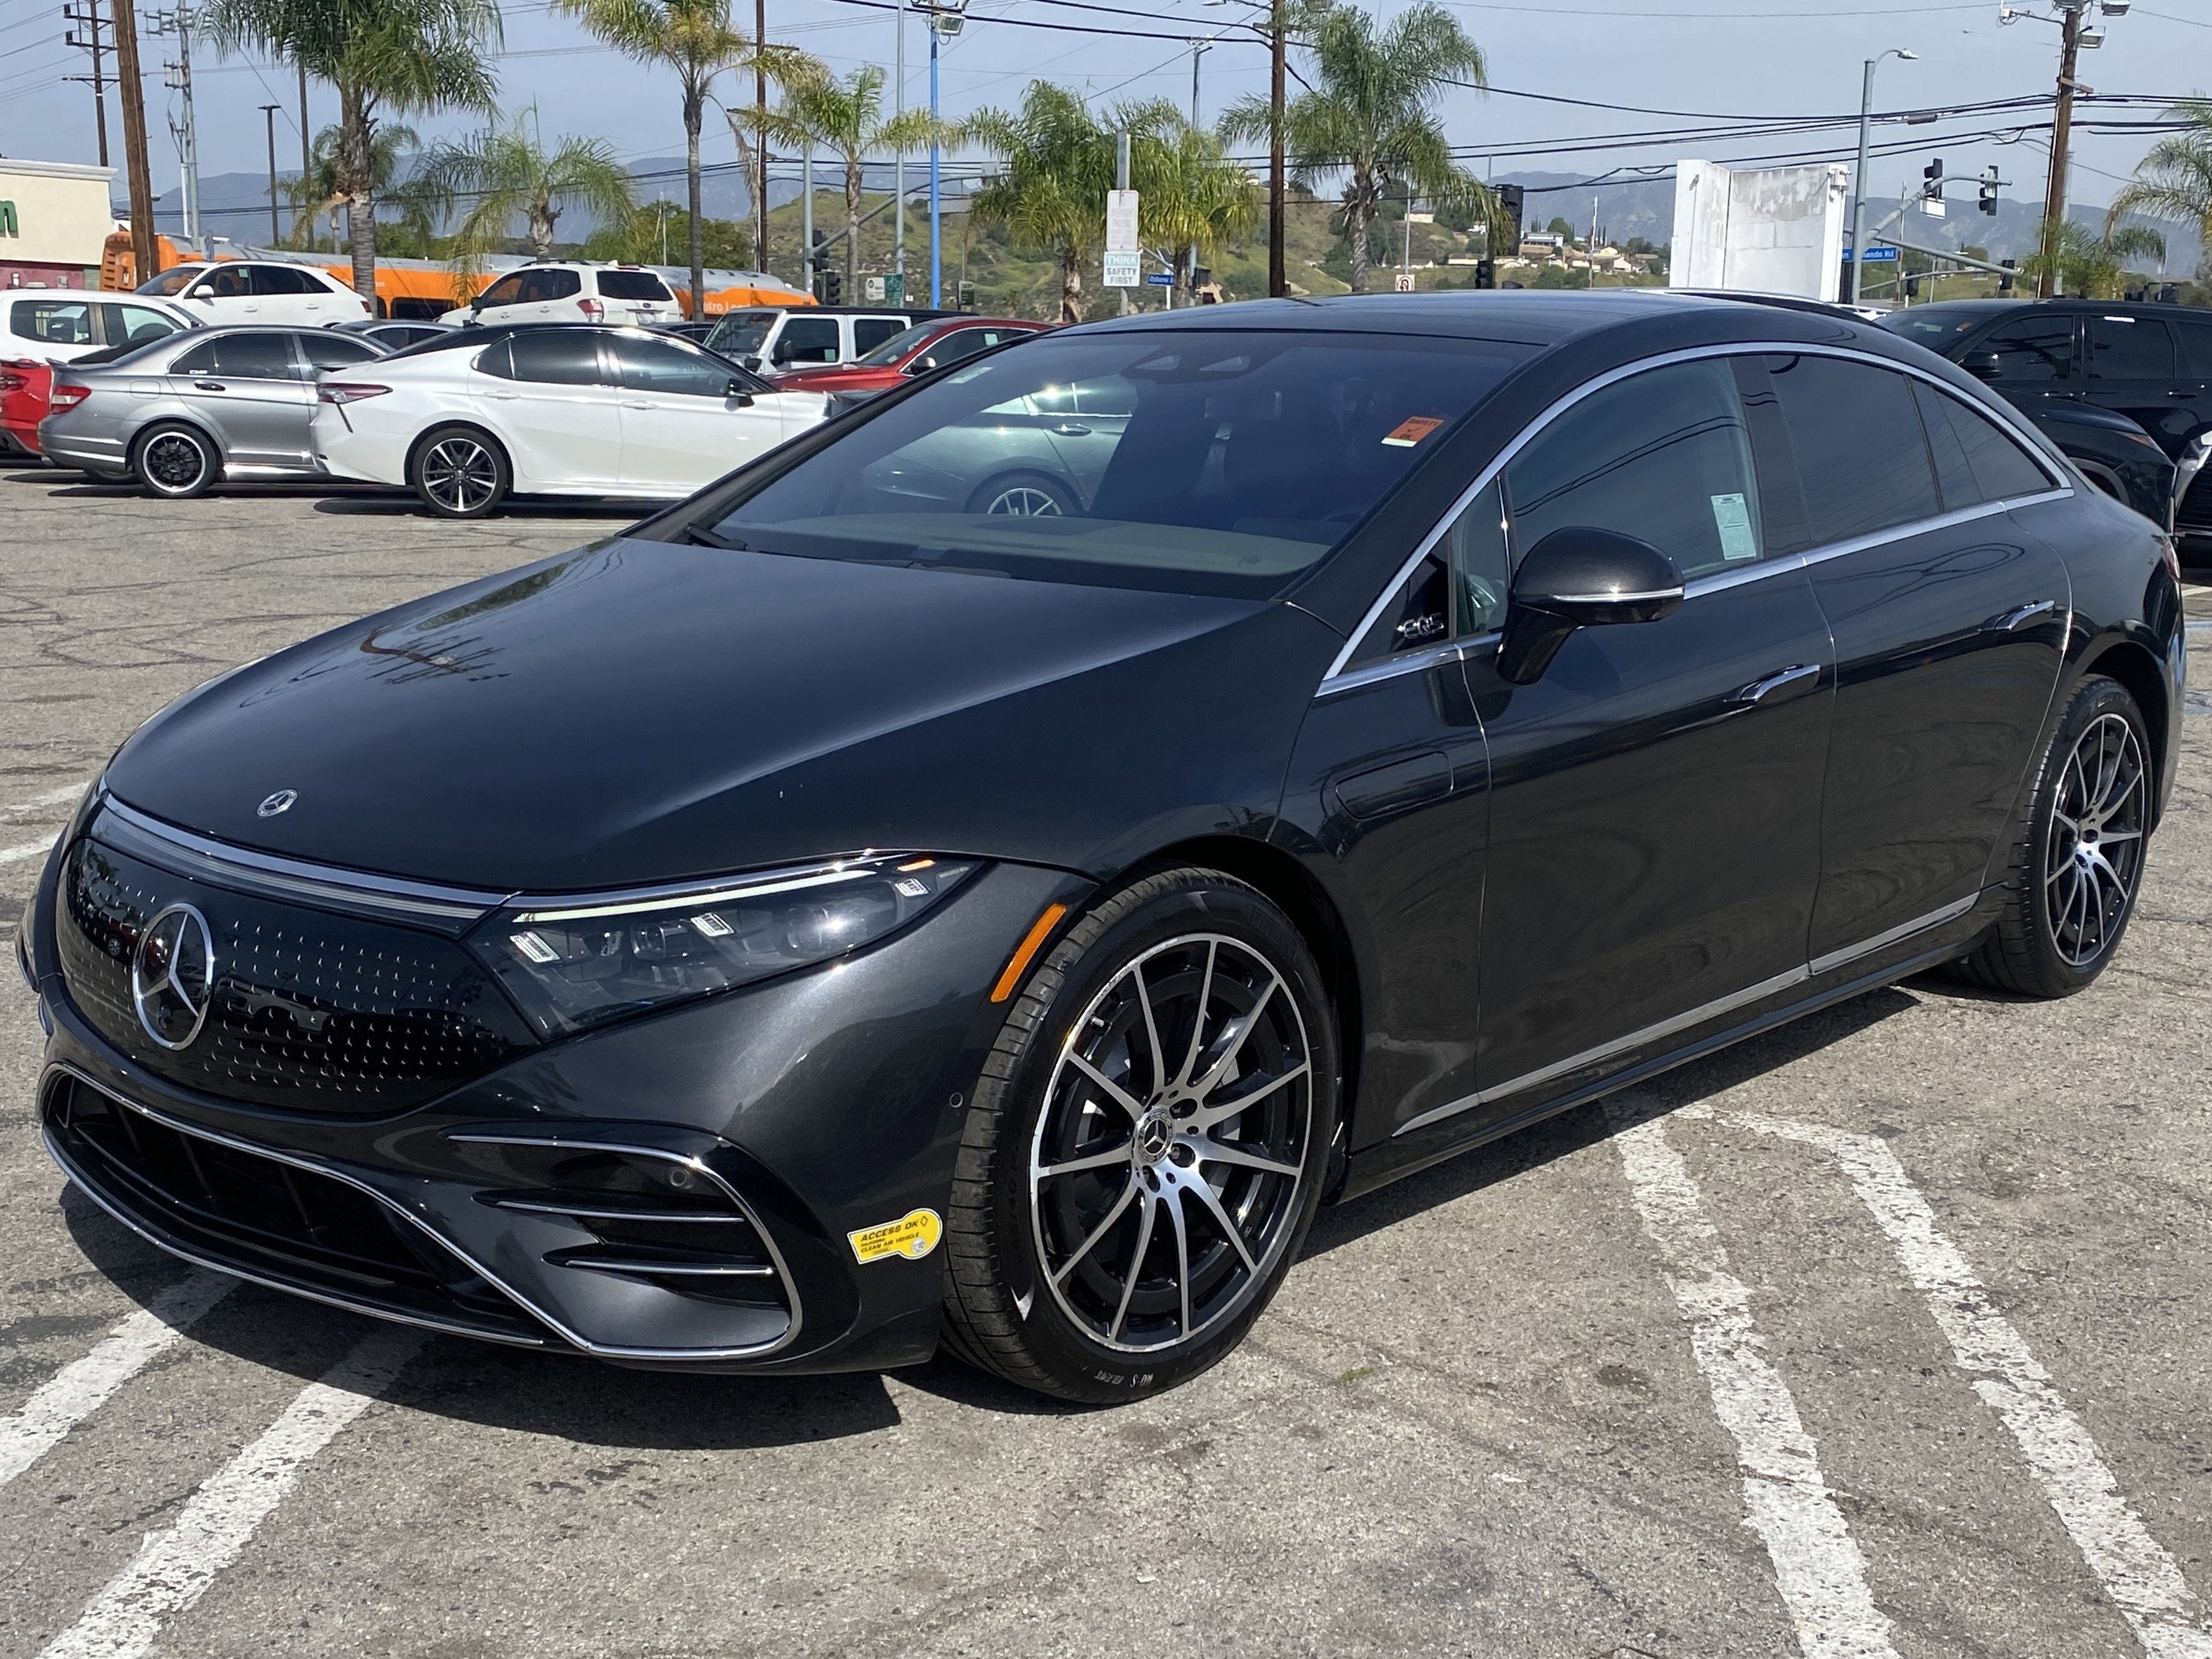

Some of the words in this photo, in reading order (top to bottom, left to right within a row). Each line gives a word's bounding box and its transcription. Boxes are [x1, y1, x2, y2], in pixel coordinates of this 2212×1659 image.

[1106, 255, 1137, 265] THINK
[1107, 267, 1137, 276] SAFETY
[860, 1225, 902, 1242] ACCESS
[904, 1219, 918, 1230] OK
[860, 1243, 882, 1253] CLEAN
